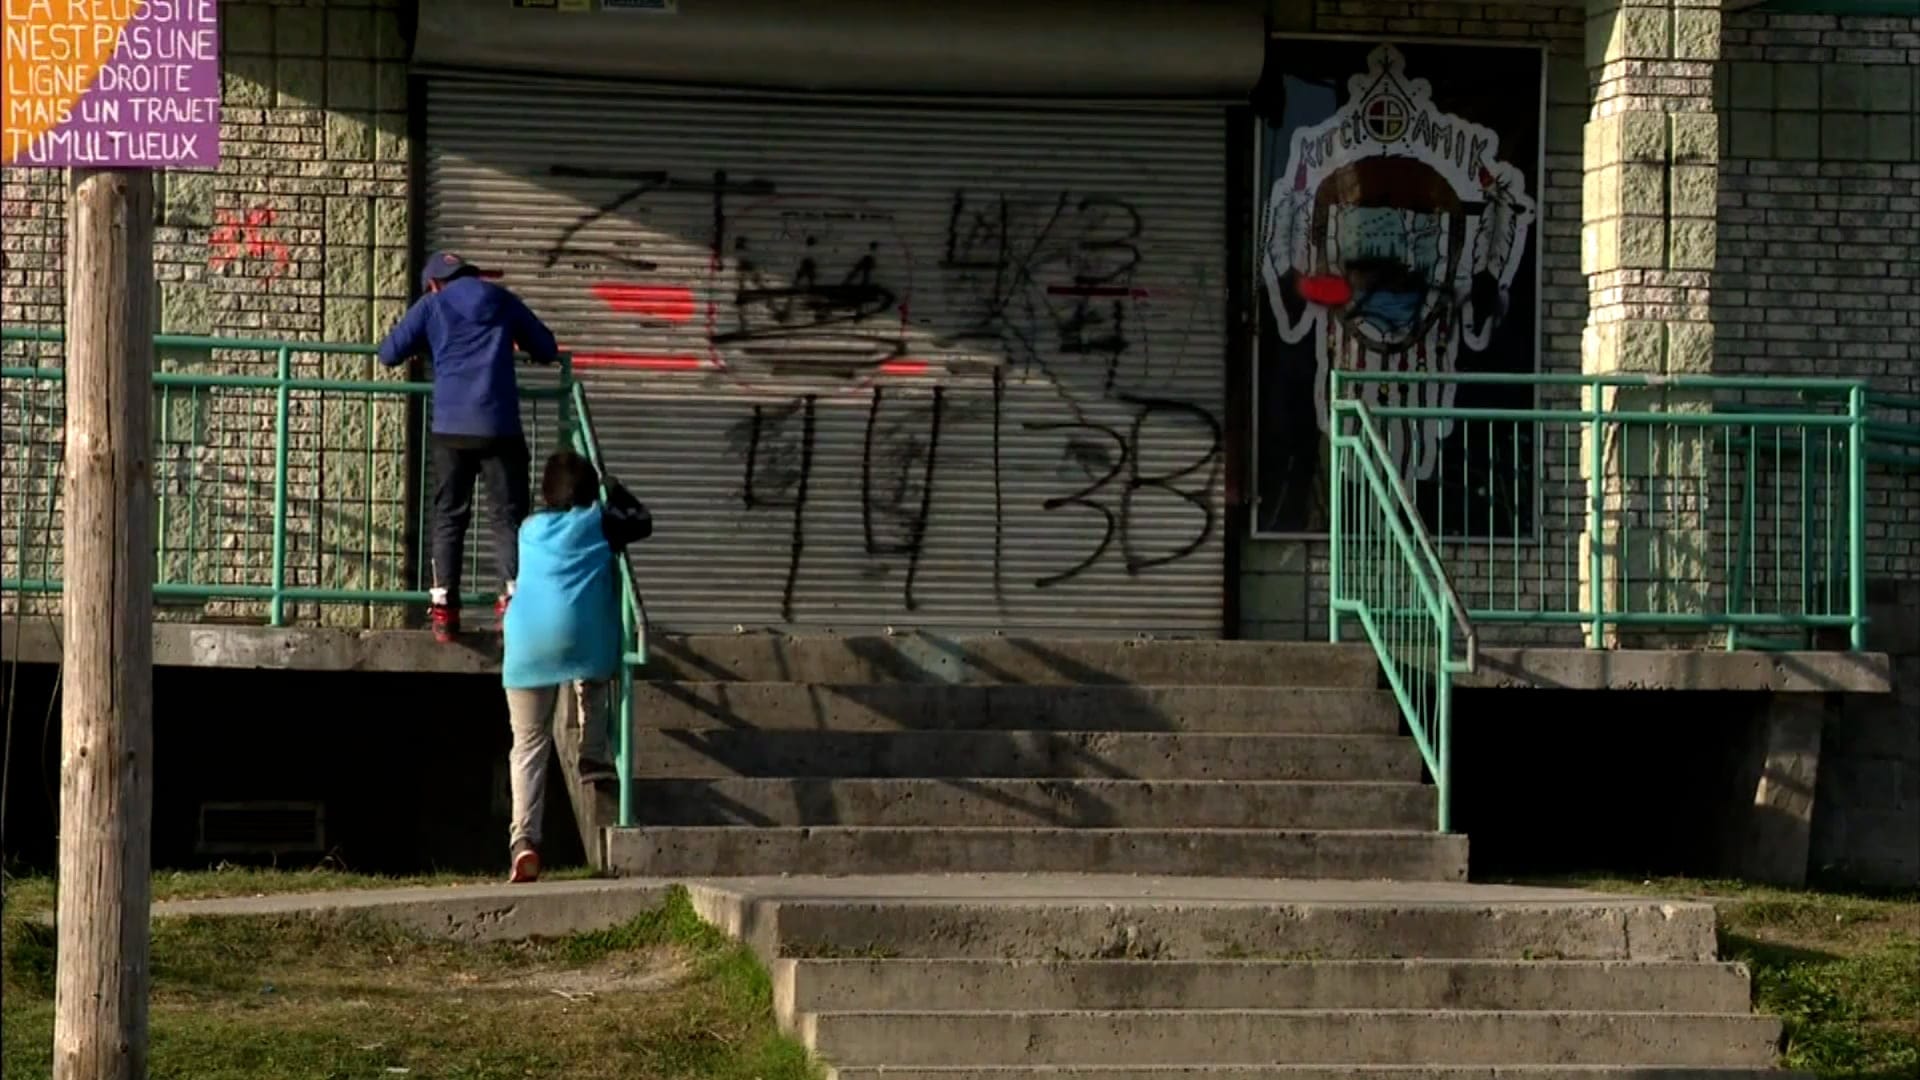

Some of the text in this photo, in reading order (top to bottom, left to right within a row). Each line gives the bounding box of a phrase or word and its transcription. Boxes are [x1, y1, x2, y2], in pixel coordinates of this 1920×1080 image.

[6, 0, 52, 20] LA
[93, 23, 152, 61] PAS
[156, 27, 217, 60] UNE
[8, 63, 193, 95] LIGNE DROITE
[10, 97, 219, 125] MAIS UN TRAJET
[5, 128, 199, 163] TUMULTUEUX
[1411, 108, 1489, 182] AMIK
